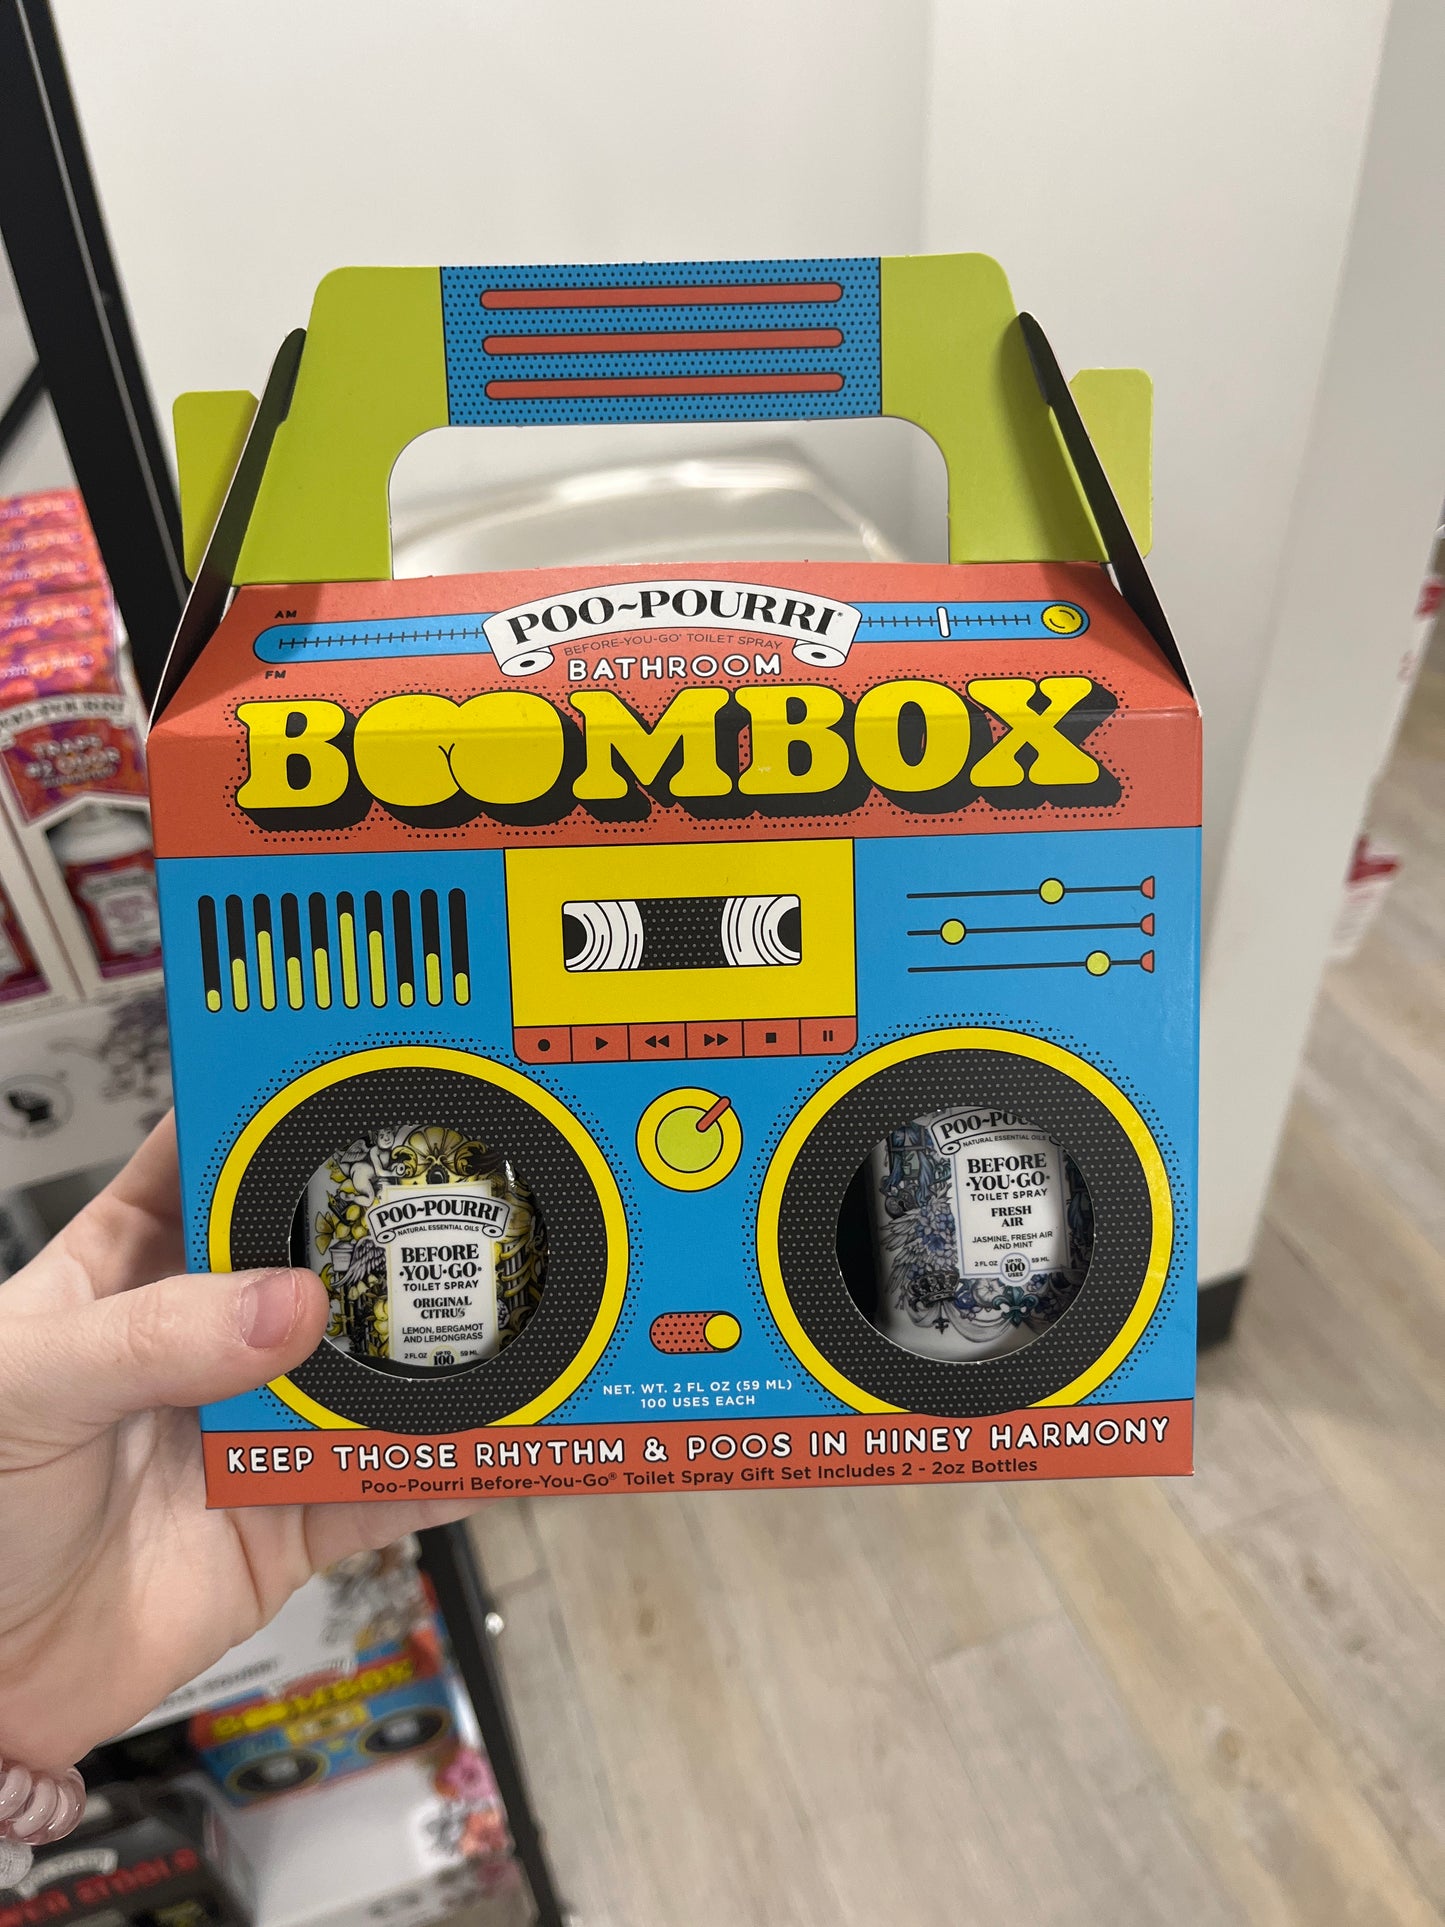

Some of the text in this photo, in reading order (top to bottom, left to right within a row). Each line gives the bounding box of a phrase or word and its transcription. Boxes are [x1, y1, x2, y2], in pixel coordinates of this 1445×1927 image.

[274, 610, 297, 619] AM
[688, 633, 734, 644] TOILET
[739, 636, 783, 650] SPRAY
[568, 653, 782, 681] BATHROOM
[265, 670, 286, 679] FM
[235, 676, 1106, 814] BOOMBOX
[963, 1136, 992, 1147] NATURAL
[967, 1153, 1047, 1174] BEFORE
[970, 1188, 1048, 1201] TOILET SPRAY
[991, 1205, 1032, 1217] FRESH
[1001, 1217, 1024, 1227] AIR
[397, 1223, 479, 1236] NATURAL ESSENTIAL OILS
[972, 1231, 1053, 1243] JASMINE, FRESH AIR
[401, 1243, 479, 1263] BEFORE
[1005, 1262, 1025, 1273] 100
[403, 1280, 479, 1292] TOILET SPRAY
[413, 1296, 472, 1308] ORIGINAL
[421, 1307, 466, 1319] CITRUS
[402, 1323, 484, 1335] LEMON, BERGAMOT
[403, 1332, 483, 1343] AND LEMONGRASS
[433, 1355, 455, 1366] 100
[603, 1379, 792, 1396] NET. WT. 2 FL OZ (59 ML)
[641, 1395, 756, 1409] 100 USES EACH
[226, 1417, 1169, 1473] KEEP THOSE RHYTHM & POOS IN HINEY HARMONY
[623, 1471, 675, 1486] Toilet
[682, 1470, 735, 1486] Spray
[740, 1465, 774, 1481] Gift
[781, 1464, 810, 1480] Set
[817, 1461, 895, 1480] Includes
[901, 1462, 913, 1476] 2
[931, 1460, 965, 1475] 2oz
[971, 1457, 1038, 1474] Bottles
